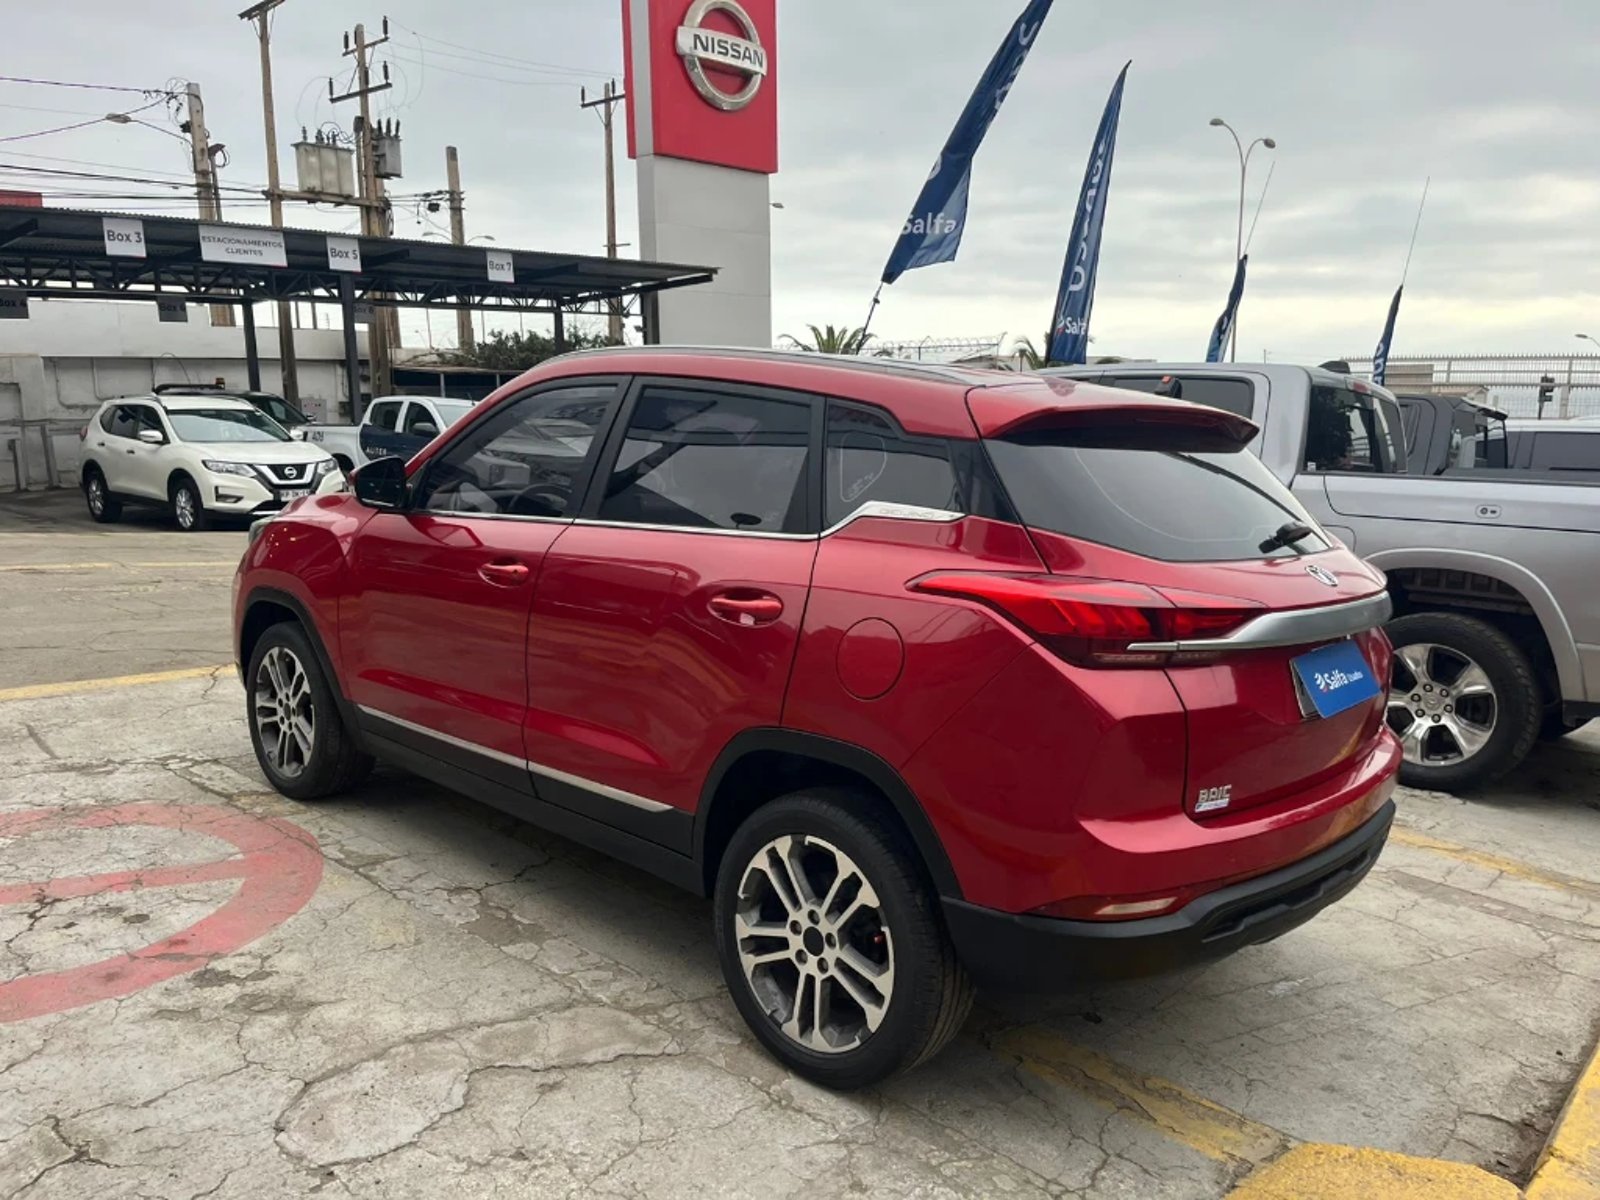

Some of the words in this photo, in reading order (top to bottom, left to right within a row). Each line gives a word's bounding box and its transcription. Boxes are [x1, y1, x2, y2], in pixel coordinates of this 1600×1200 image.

[693, 34, 763, 68] NISSAN
[902, 212, 956, 235] Salfa
[107, 229, 132, 243] Box
[134, 231, 142, 243] 3
[202, 235, 283, 248] ESTACIONAMIENTOS
[225, 246, 264, 256] CLIENTES
[331, 248, 349, 259] Box
[352, 249, 359, 260] 5
[489, 260, 505, 271] Box
[506, 261, 511, 271] 7
[159, 302, 177, 312] Box
[1323, 669, 1348, 690] Salfa
[1198, 784, 1232, 803] BAIC
